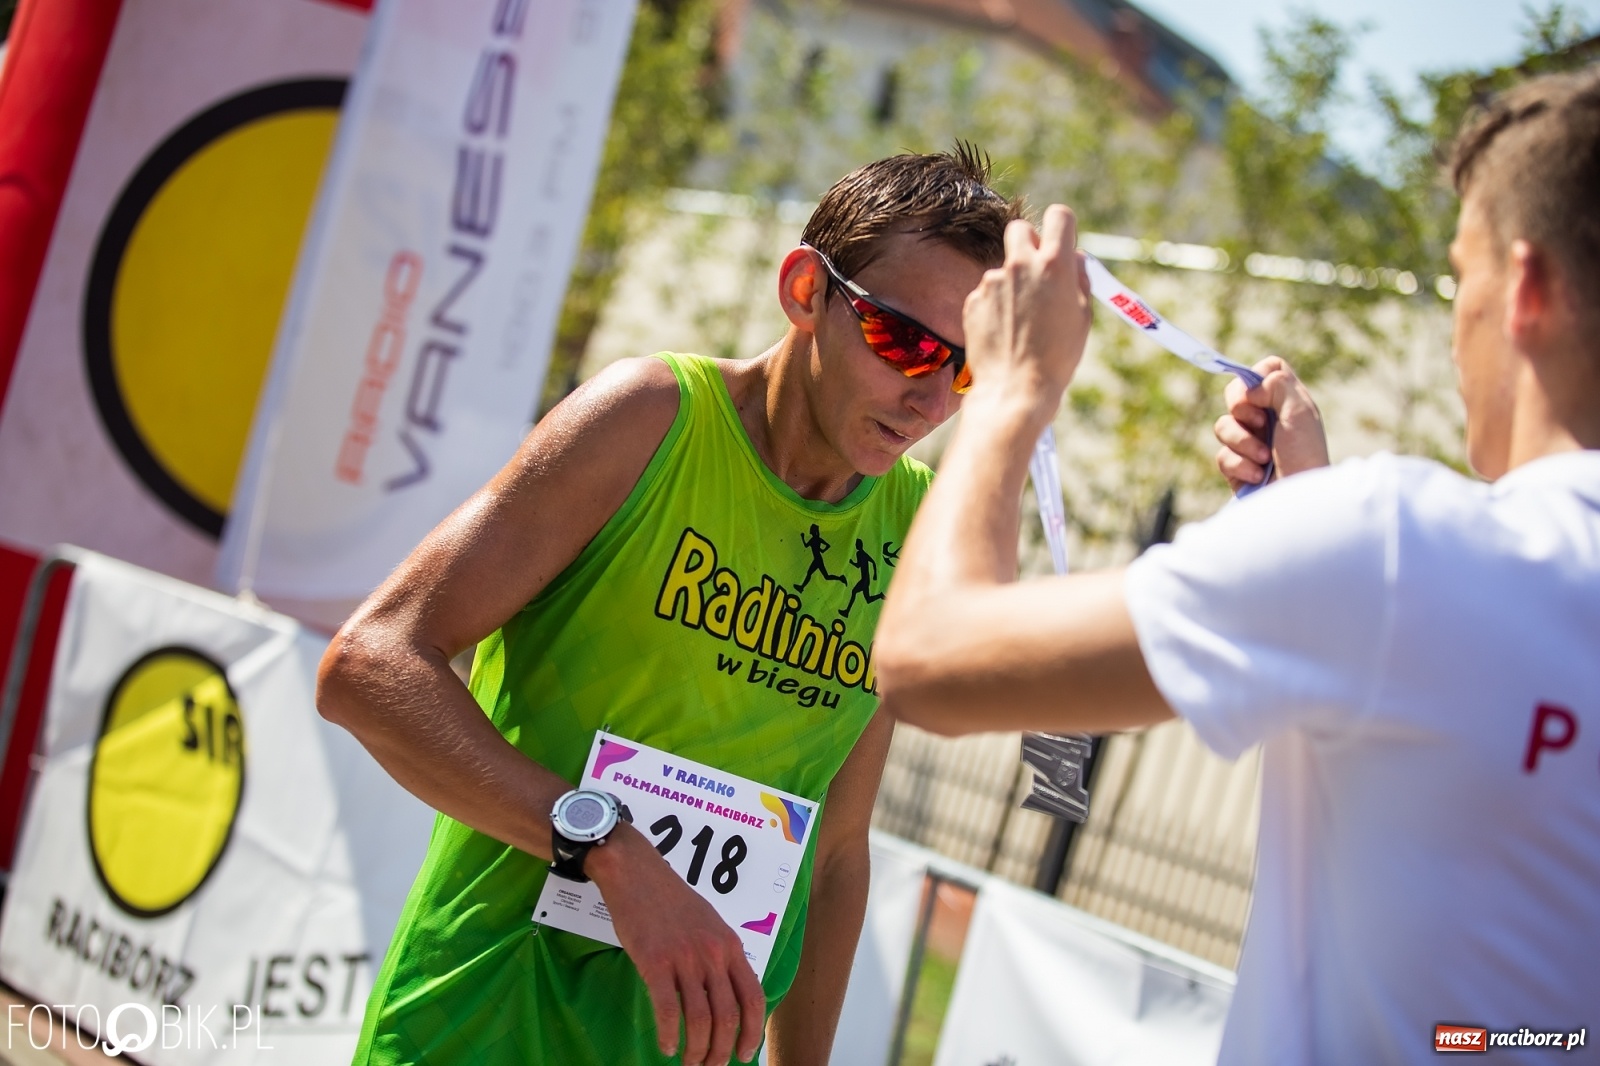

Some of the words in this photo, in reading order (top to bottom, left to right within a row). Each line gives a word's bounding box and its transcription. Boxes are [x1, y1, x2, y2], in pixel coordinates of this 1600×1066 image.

[717, 653, 743, 676] w
[746, 659, 841, 709] biegu
[1522, 702, 1600, 775] P
[612, 771, 704, 810] PÓŁMARATON
[705, 801, 765, 829] RACIBÓRZ
[662, 764, 674, 777] V
[675, 769, 736, 798] RAFAKO
[649, 814, 748, 895] 218
[227, 951, 373, 1021] JEST
